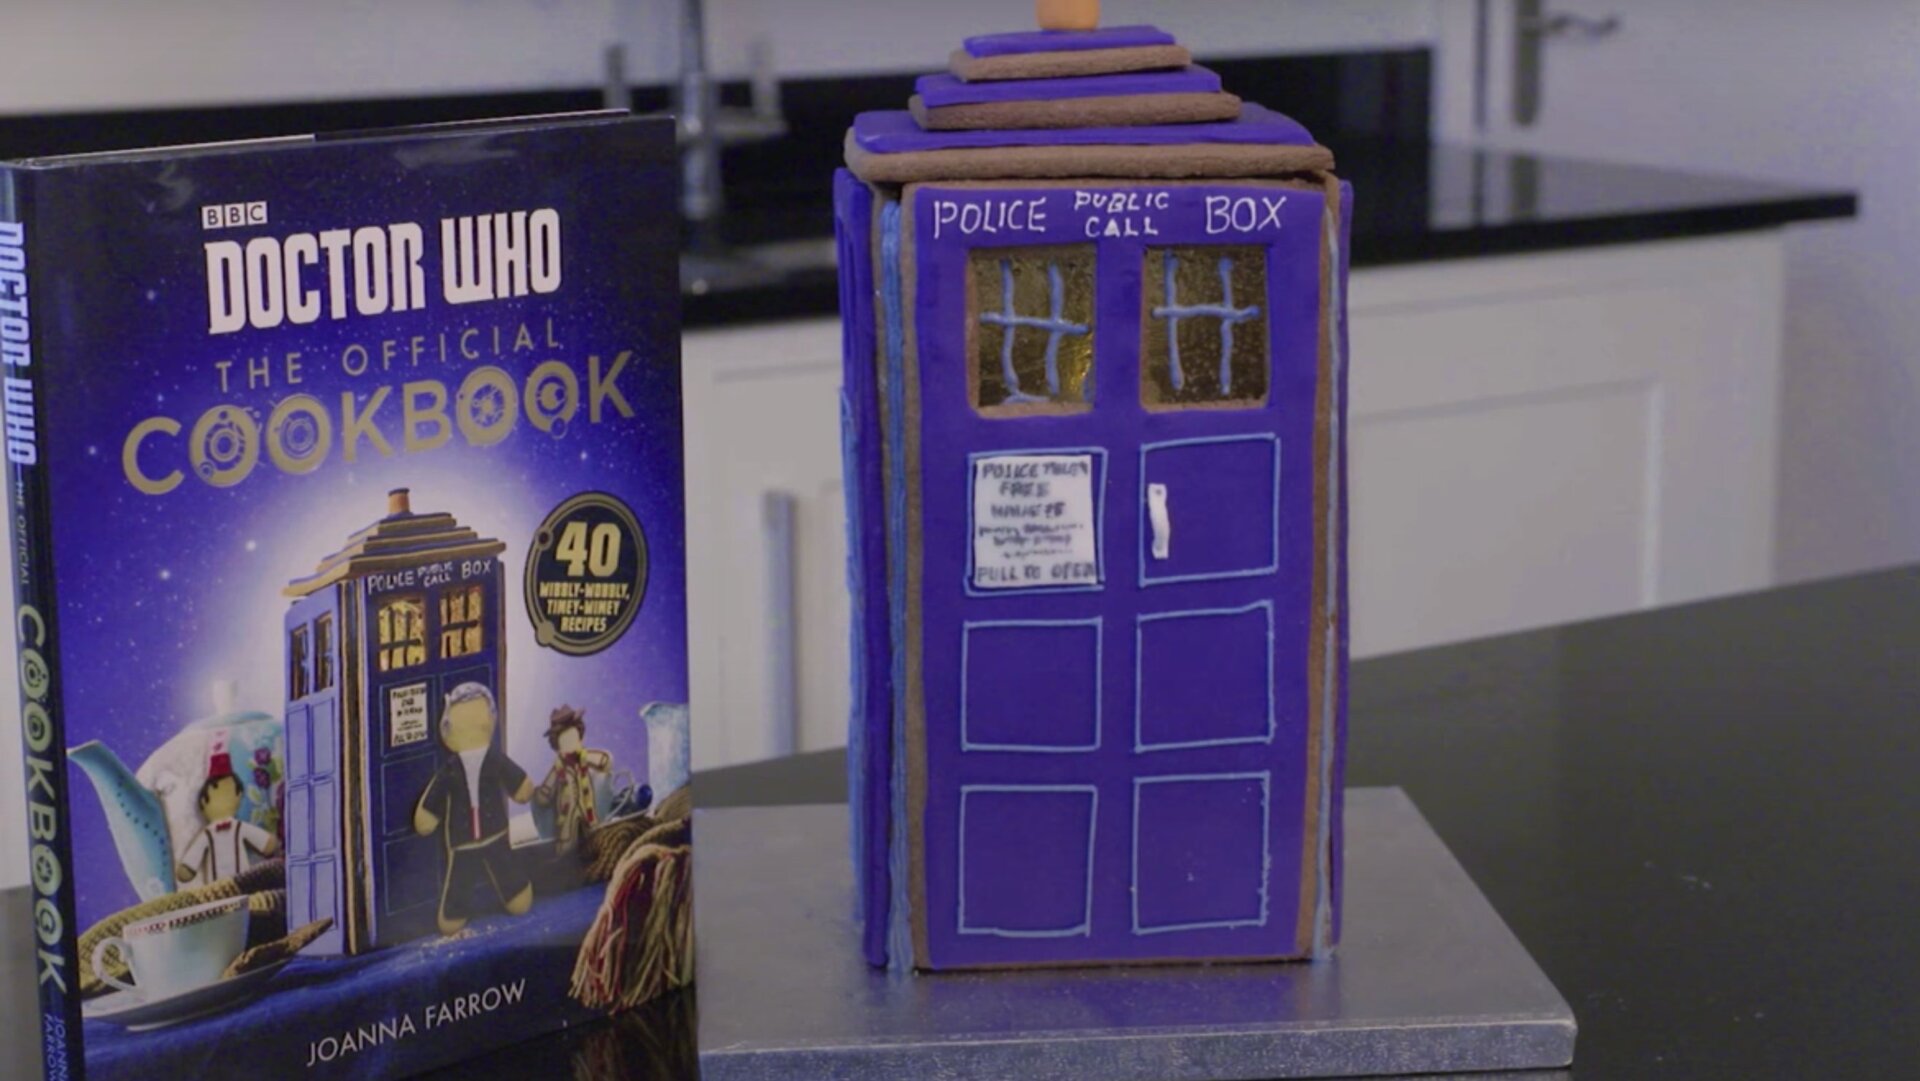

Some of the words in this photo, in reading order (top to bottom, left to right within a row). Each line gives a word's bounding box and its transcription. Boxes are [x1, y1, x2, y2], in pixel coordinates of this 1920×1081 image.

[203, 203, 266, 228] BBC
[934, 197, 1046, 239] POLICE
[1074, 191, 1169, 213] PUBLIC
[1085, 216, 1159, 237] CALL
[1205, 196, 1287, 234] BOX
[0, 222, 31, 366] DOCTOR
[204, 222, 425, 334] DOCTOR
[441, 208, 562, 304] WHO
[216, 352, 302, 393] THE
[343, 320, 560, 376] OFFICIAL
[4, 376, 37, 465] WHO
[122, 350, 635, 495] COOKBOOK
[18, 515, 30, 584] OFFICIAL
[367, 570, 414, 595] POLICE
[423, 573, 450, 588] CALL
[461, 559, 492, 579] BOX
[555, 521, 621, 577] 40
[977, 566, 1018, 582] PULL
[560, 616, 607, 633] RECIPES
[17, 604, 68, 994] COOKBOOK
[54, 1015, 69, 1081] JOANN
[307, 1013, 416, 1068] JOANNA
[425, 978, 526, 1030] FARROW
